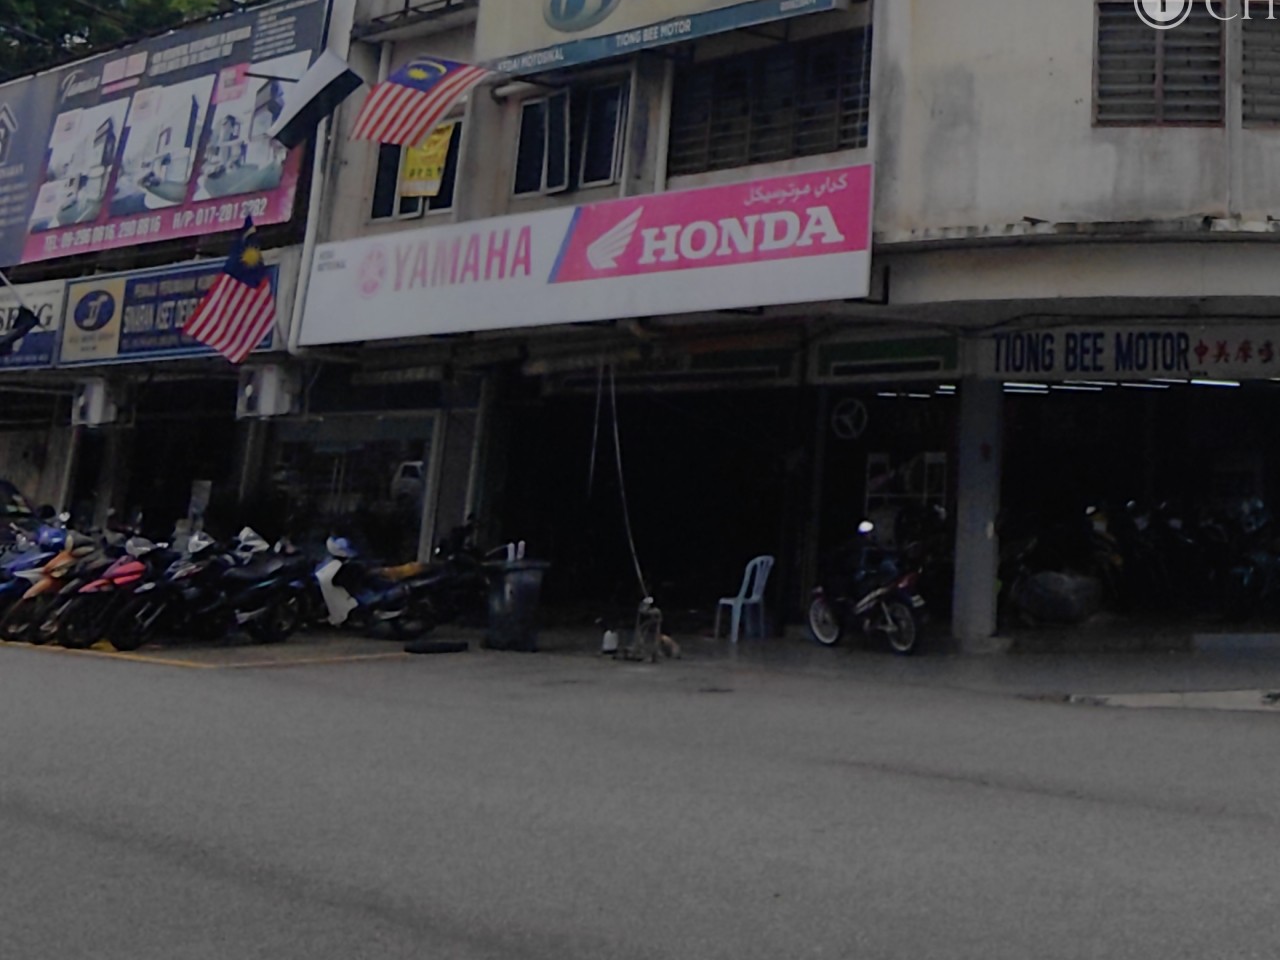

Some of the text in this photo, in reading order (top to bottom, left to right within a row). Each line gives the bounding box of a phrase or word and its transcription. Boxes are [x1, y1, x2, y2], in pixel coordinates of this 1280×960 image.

[615, 18, 692, 48] TIONG BEE MOTOR
[393, 225, 533, 292] YAMAHA
[637, 207, 845, 266] HONDA
[992, 331, 1190, 373] TIONG BEE MOTOR
